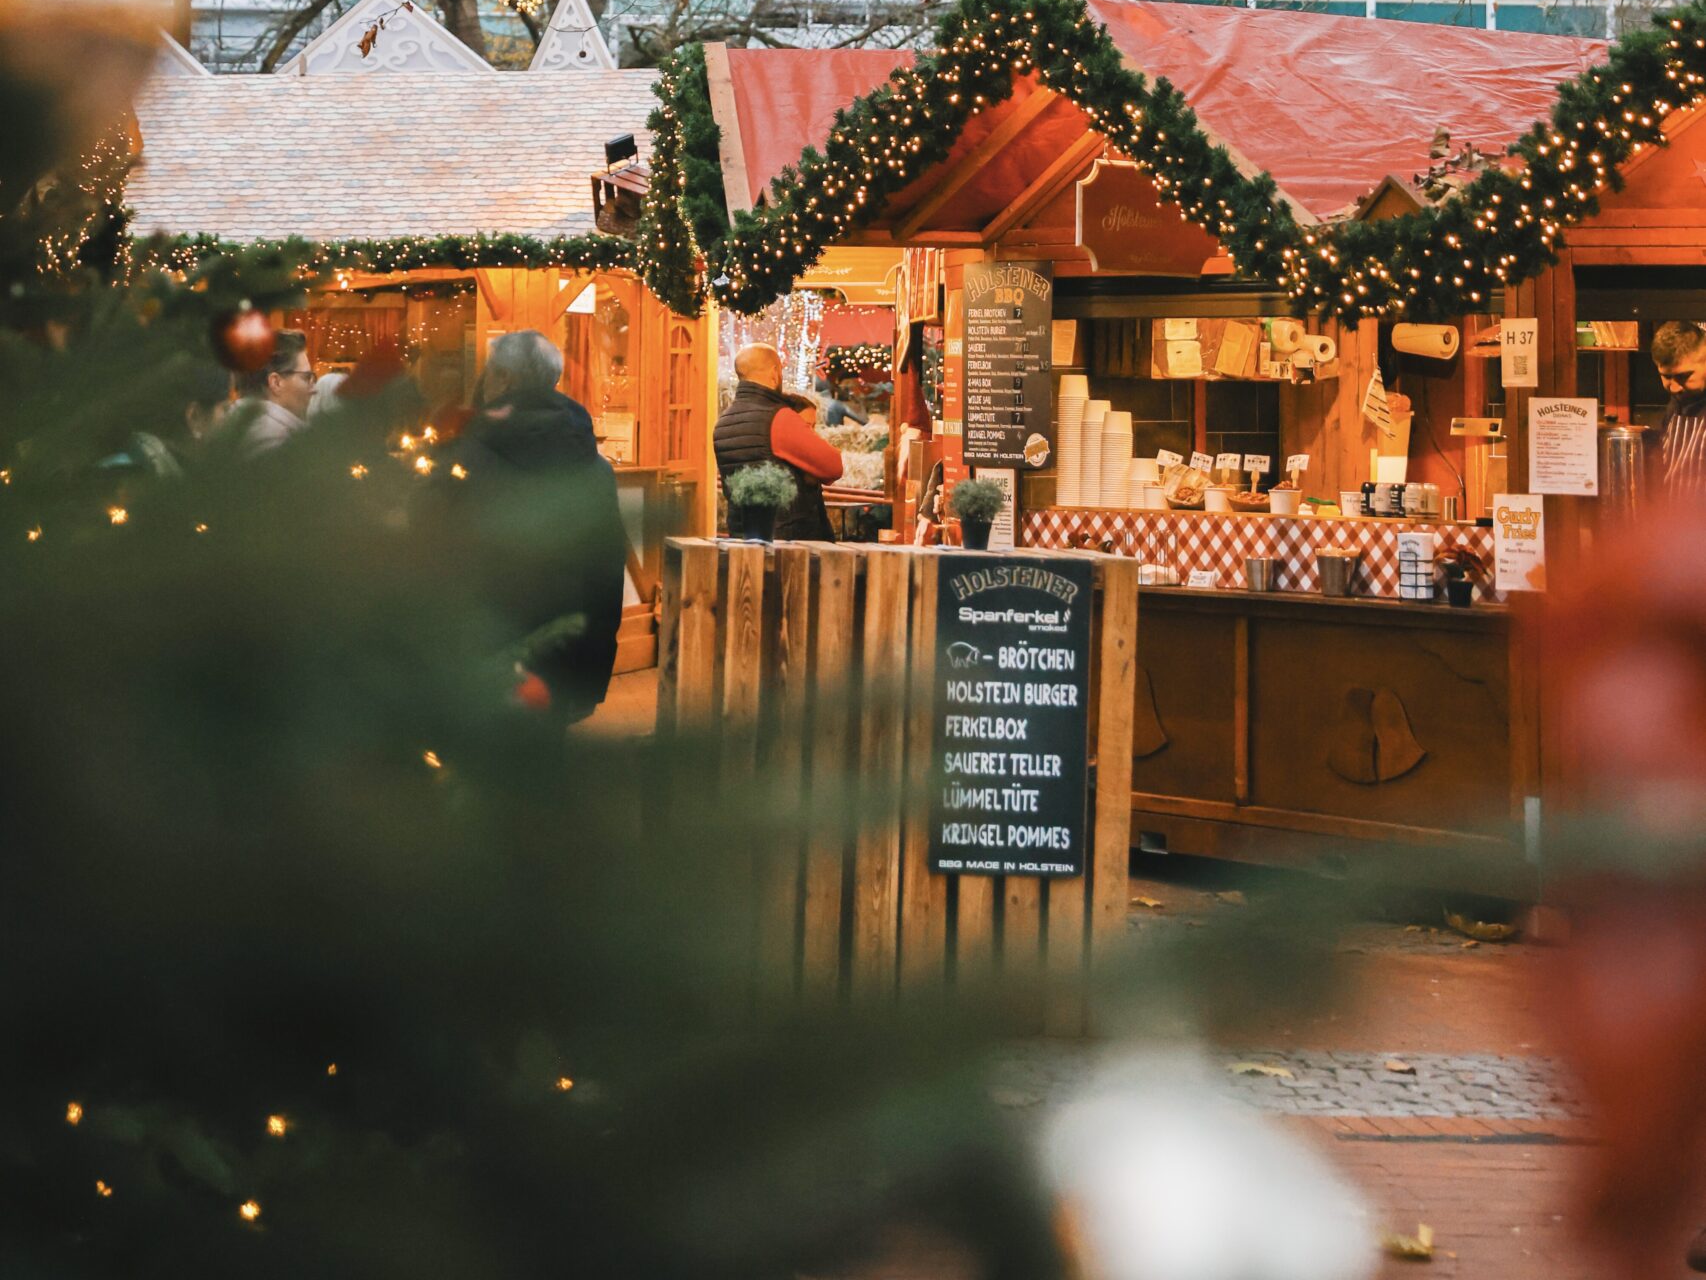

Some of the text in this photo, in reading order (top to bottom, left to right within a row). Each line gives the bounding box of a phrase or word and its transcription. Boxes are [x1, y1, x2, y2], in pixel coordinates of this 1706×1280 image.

[967, 266, 1050, 302] HOLSTEINER
[994, 288, 1024, 305] BBQ
[968, 326, 989, 335] HOLSTEIN
[990, 326, 1006, 335] BURGER
[1507, 331, 1534, 344] H 37
[1537, 403, 1588, 418] HOLSTEINER
[1497, 506, 1541, 529] Curly
[1503, 524, 1537, 540] Fries
[950, 566, 1078, 604] HOLSTEINER
[958, 607, 1059, 624] Spanferkel
[1028, 624, 1067, 632] smoked
[998, 640, 1075, 670] BRÖTCHEN
[947, 681, 1078, 706] HOLSTEIN BURGER
[946, 715, 1028, 740] FERKELBOX
[944, 752, 1061, 776] SAUEREI TELLER
[943, 781, 1039, 812] LÜMMELTÜTE
[942, 823, 1070, 849] KRINGEL POMMES
[939, 859, 1074, 872] BBQ MADE IN HOLSTEIN
